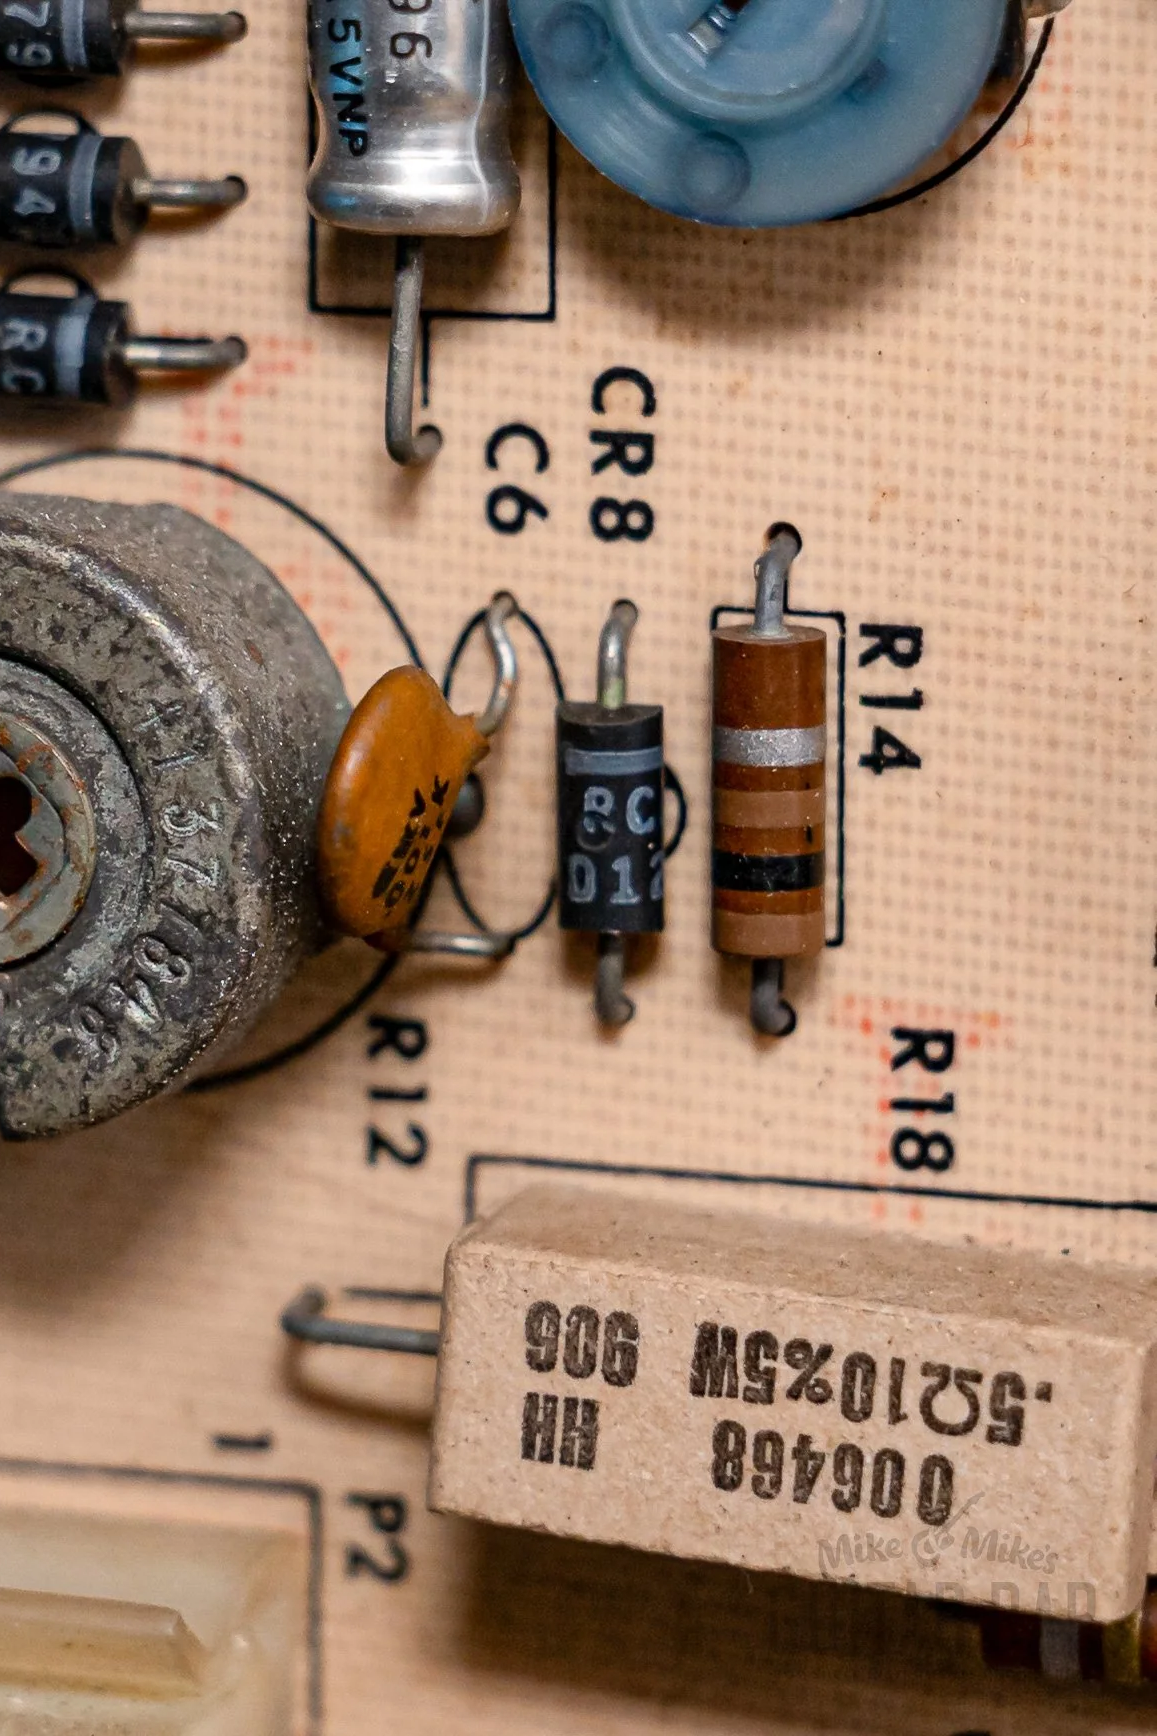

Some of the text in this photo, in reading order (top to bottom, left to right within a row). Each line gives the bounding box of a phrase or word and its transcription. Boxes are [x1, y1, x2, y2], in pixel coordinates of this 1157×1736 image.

[328, 0, 369, 157] 5VNP
[483, 421, 551, 537] C6
[589, 365, 657, 545] CR8
[856, 621, 926, 777] R14
[365, 1015, 431, 1168] R12
[889, 1024, 957, 1174] R18
[519, 1390, 601, 1472] HH
[342, 1489, 411, 1584] P2
